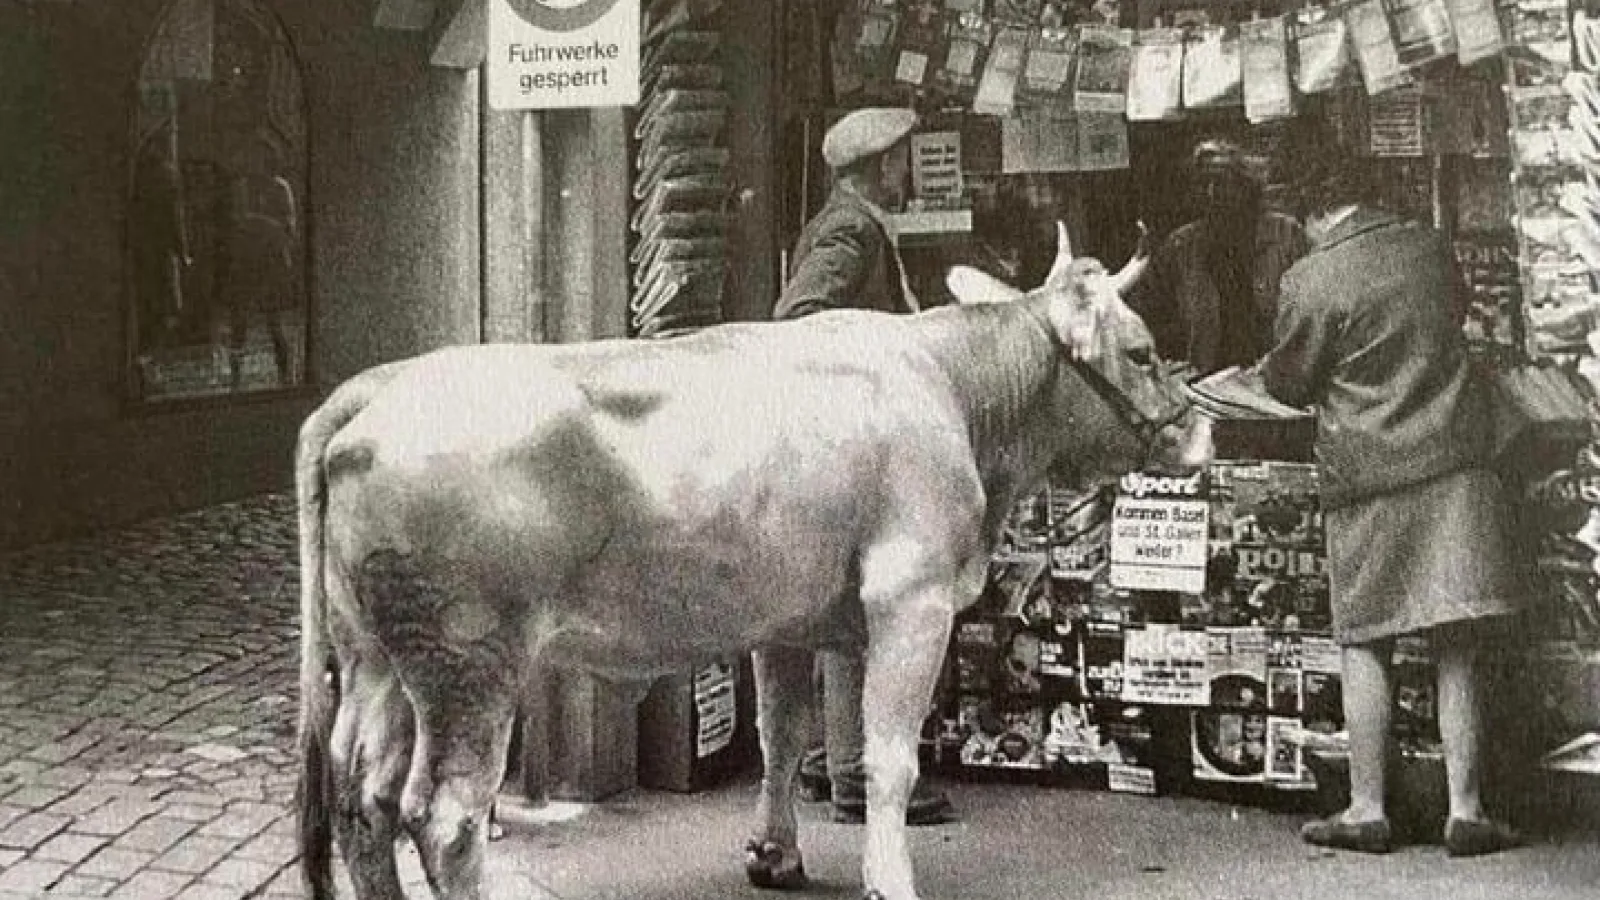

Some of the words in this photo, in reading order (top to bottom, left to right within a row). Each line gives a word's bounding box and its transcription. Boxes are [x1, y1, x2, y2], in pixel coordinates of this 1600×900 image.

[509, 41, 619, 62] Fuhrwerke
[519, 66, 608, 95] gesperrt
[1115, 507, 1168, 520] Kommen
